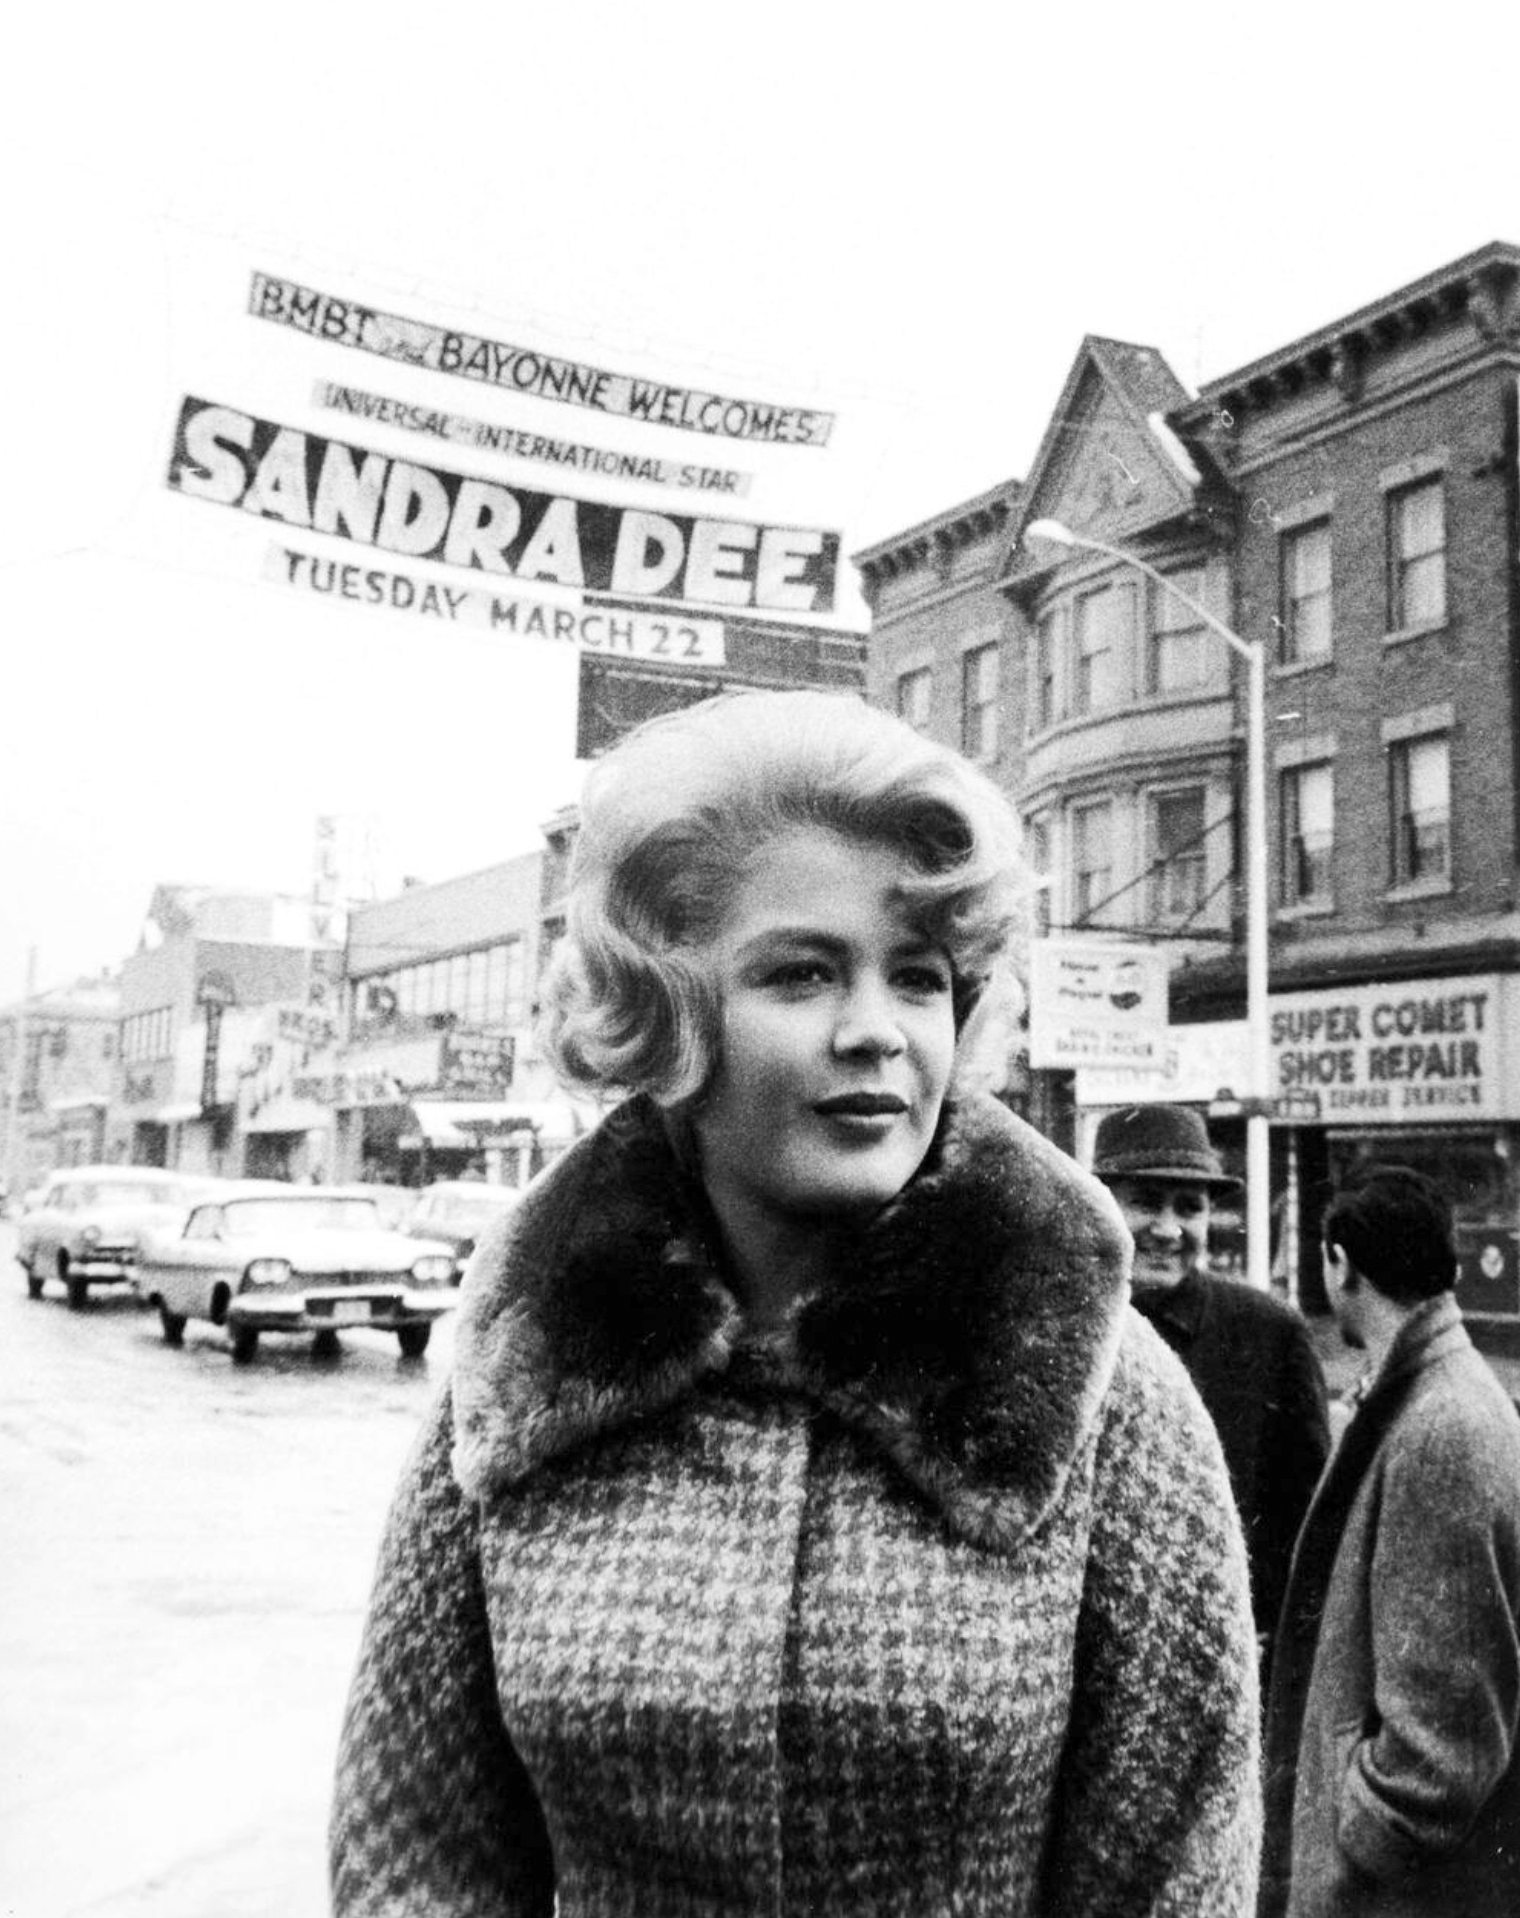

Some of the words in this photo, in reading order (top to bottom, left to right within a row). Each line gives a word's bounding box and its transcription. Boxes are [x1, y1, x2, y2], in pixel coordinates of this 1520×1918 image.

[260, 280, 376, 343] BMBT
[438, 332, 612, 406] BAYONNE
[628, 378, 818, 443] WELCOMES
[172, 405, 584, 592] SANDRA
[610, 508, 824, 612] DEE
[679, 465, 741, 493] STAR
[285, 549, 467, 620] TUESDAY
[490, 598, 634, 651] MARCH
[650, 624, 704, 657] 22
[1271, 1006, 1362, 1046] SUPER
[1372, 993, 1489, 1039] COMET
[1280, 1048, 1356, 1085] SHOE
[1369, 1040, 1482, 1081] REPAIR
